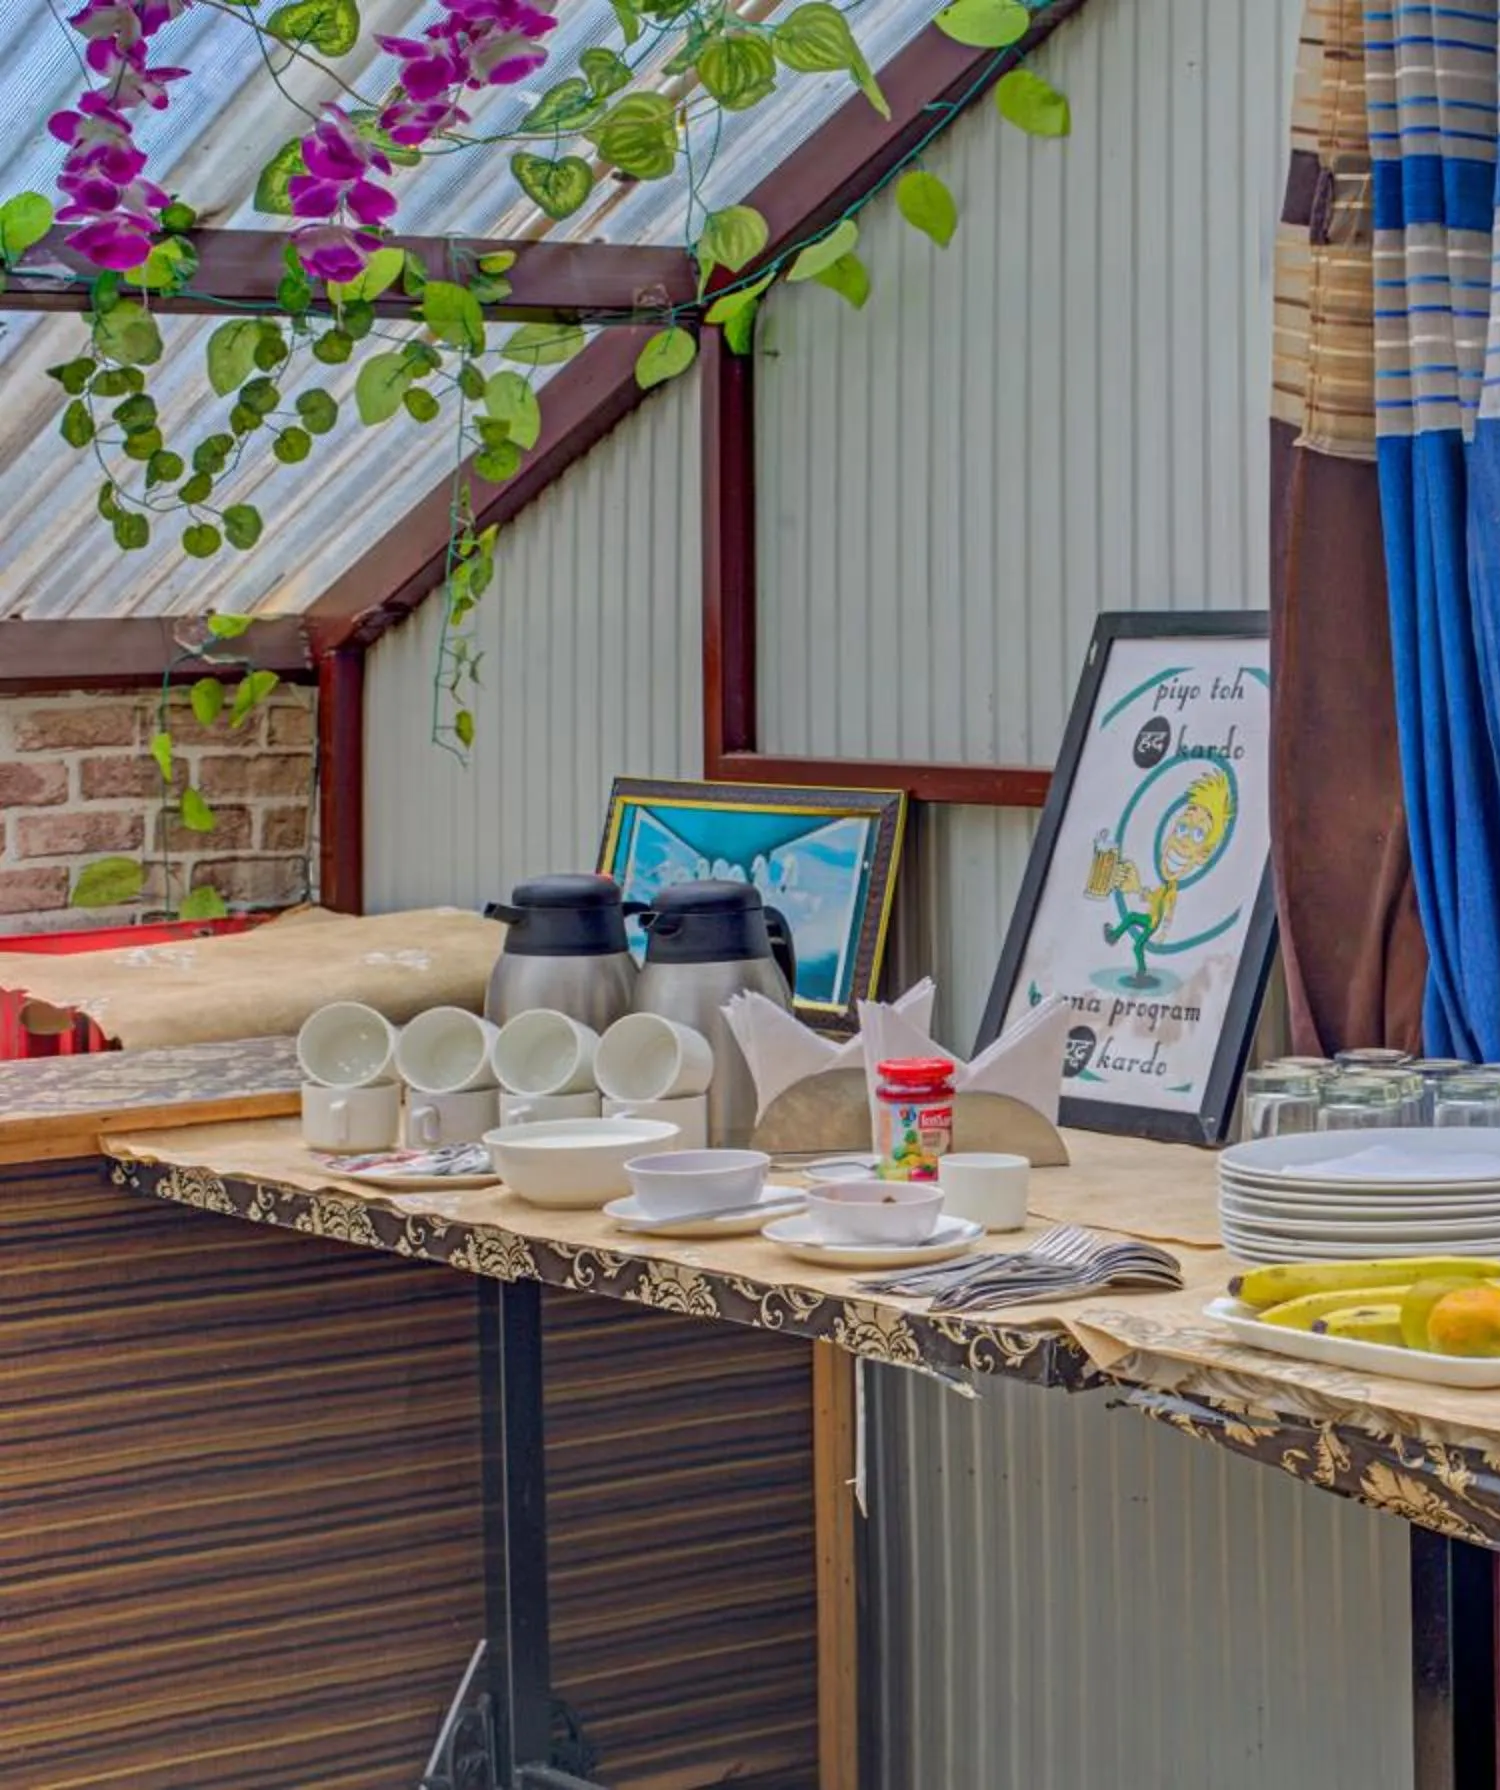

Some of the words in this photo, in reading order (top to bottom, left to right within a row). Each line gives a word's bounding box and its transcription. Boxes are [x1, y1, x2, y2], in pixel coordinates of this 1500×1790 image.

[1152, 676, 1201, 712] piyo
[1210, 667, 1244, 700] toh
[1175, 724, 1246, 760] kardo
[1107, 997, 1201, 1032] program
[1096, 1035, 1168, 1076] kardo
